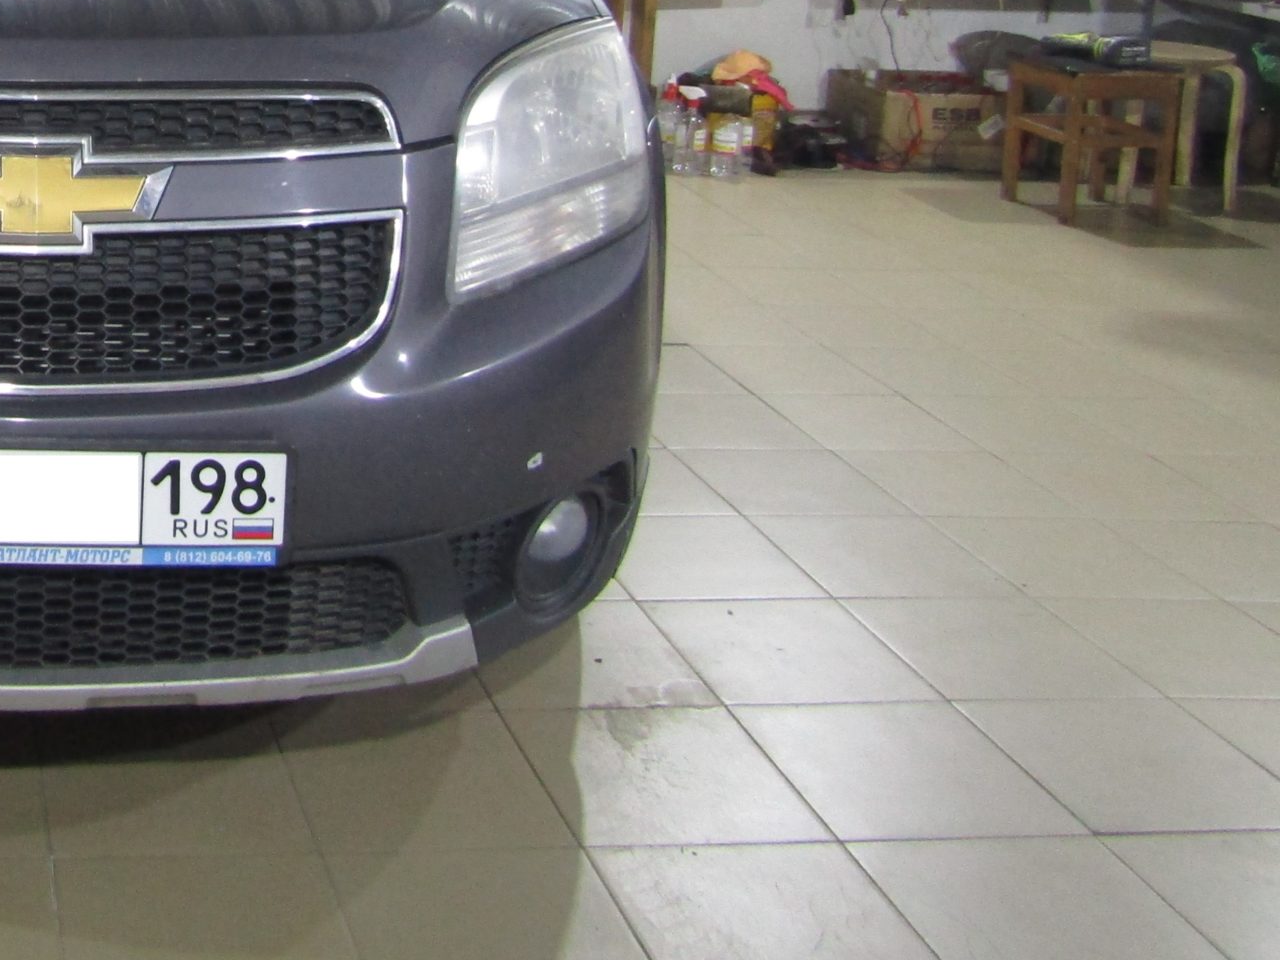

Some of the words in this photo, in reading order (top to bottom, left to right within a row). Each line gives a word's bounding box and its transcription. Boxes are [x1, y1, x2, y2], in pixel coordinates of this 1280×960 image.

[150, 459, 267, 515] 198
[172, 519, 228, 538] RUS
[175, 550, 207, 563] (812)
